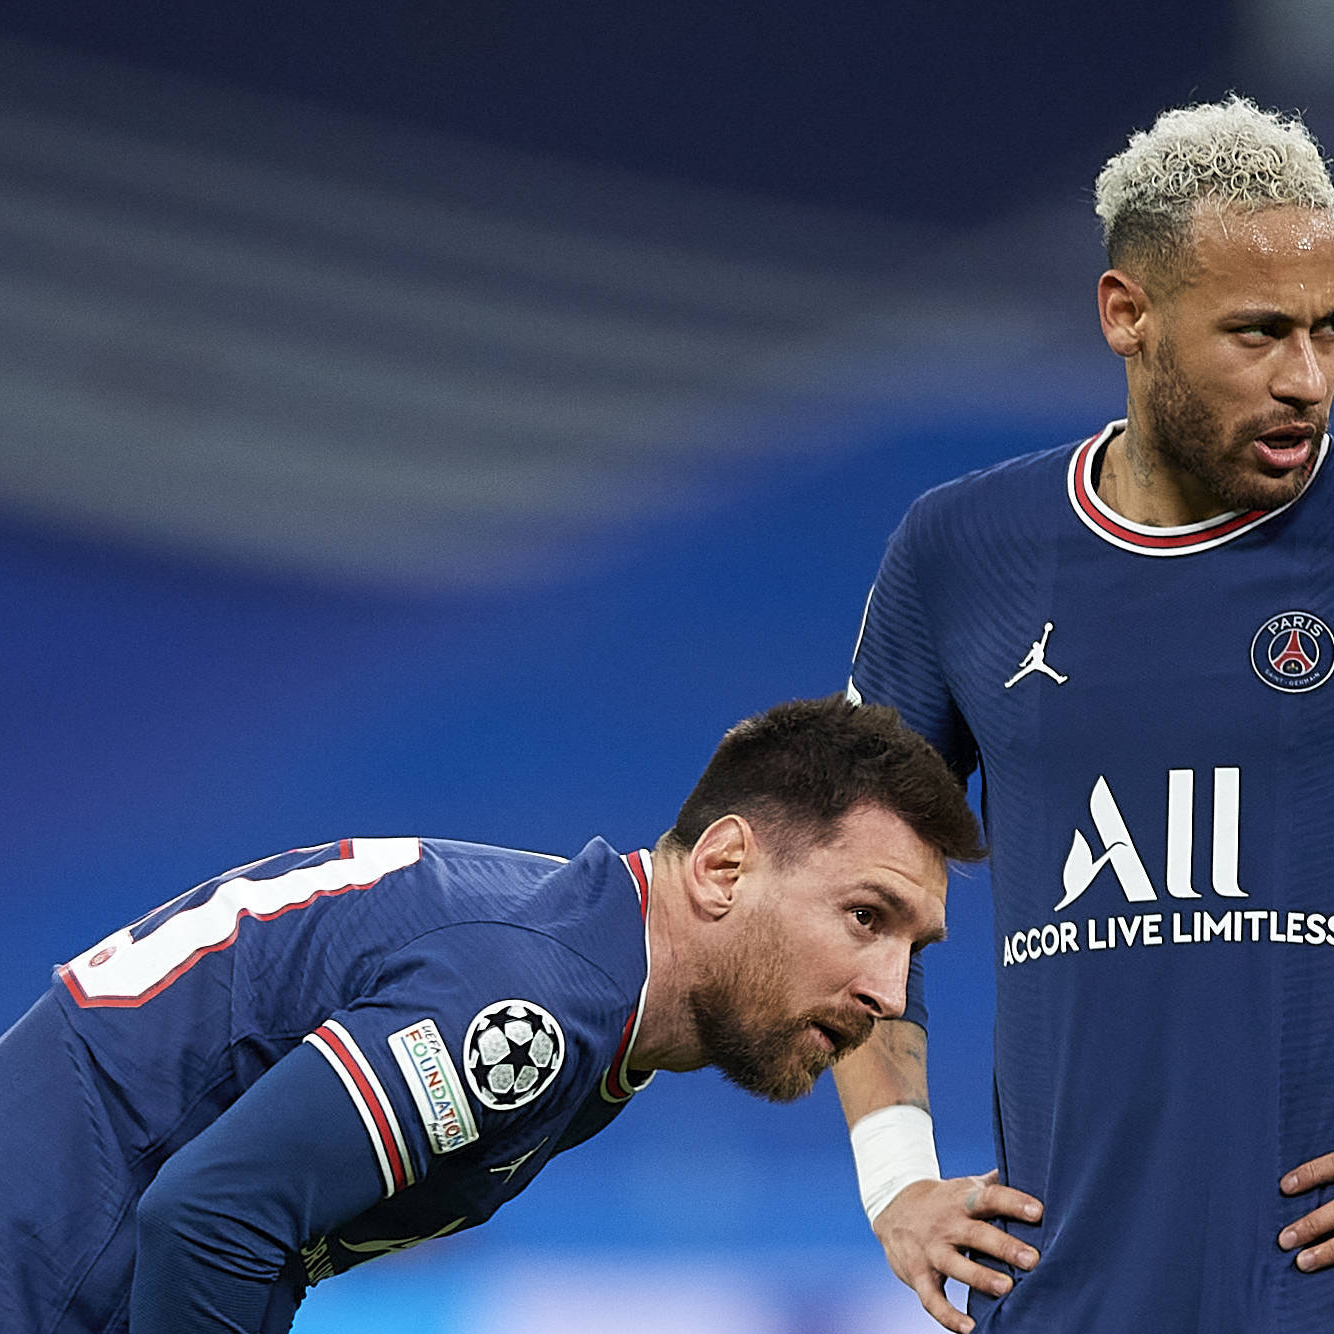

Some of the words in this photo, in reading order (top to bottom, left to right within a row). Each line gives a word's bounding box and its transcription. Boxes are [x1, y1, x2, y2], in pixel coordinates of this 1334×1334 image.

[1267, 615, 1324, 637] PARIS
[1003, 920, 1080, 968] ACCOR
[1087, 913, 1163, 951] LIVE
[421, 1025, 442, 1054] UEFA
[405, 1028, 464, 1148] FOUNDATION
